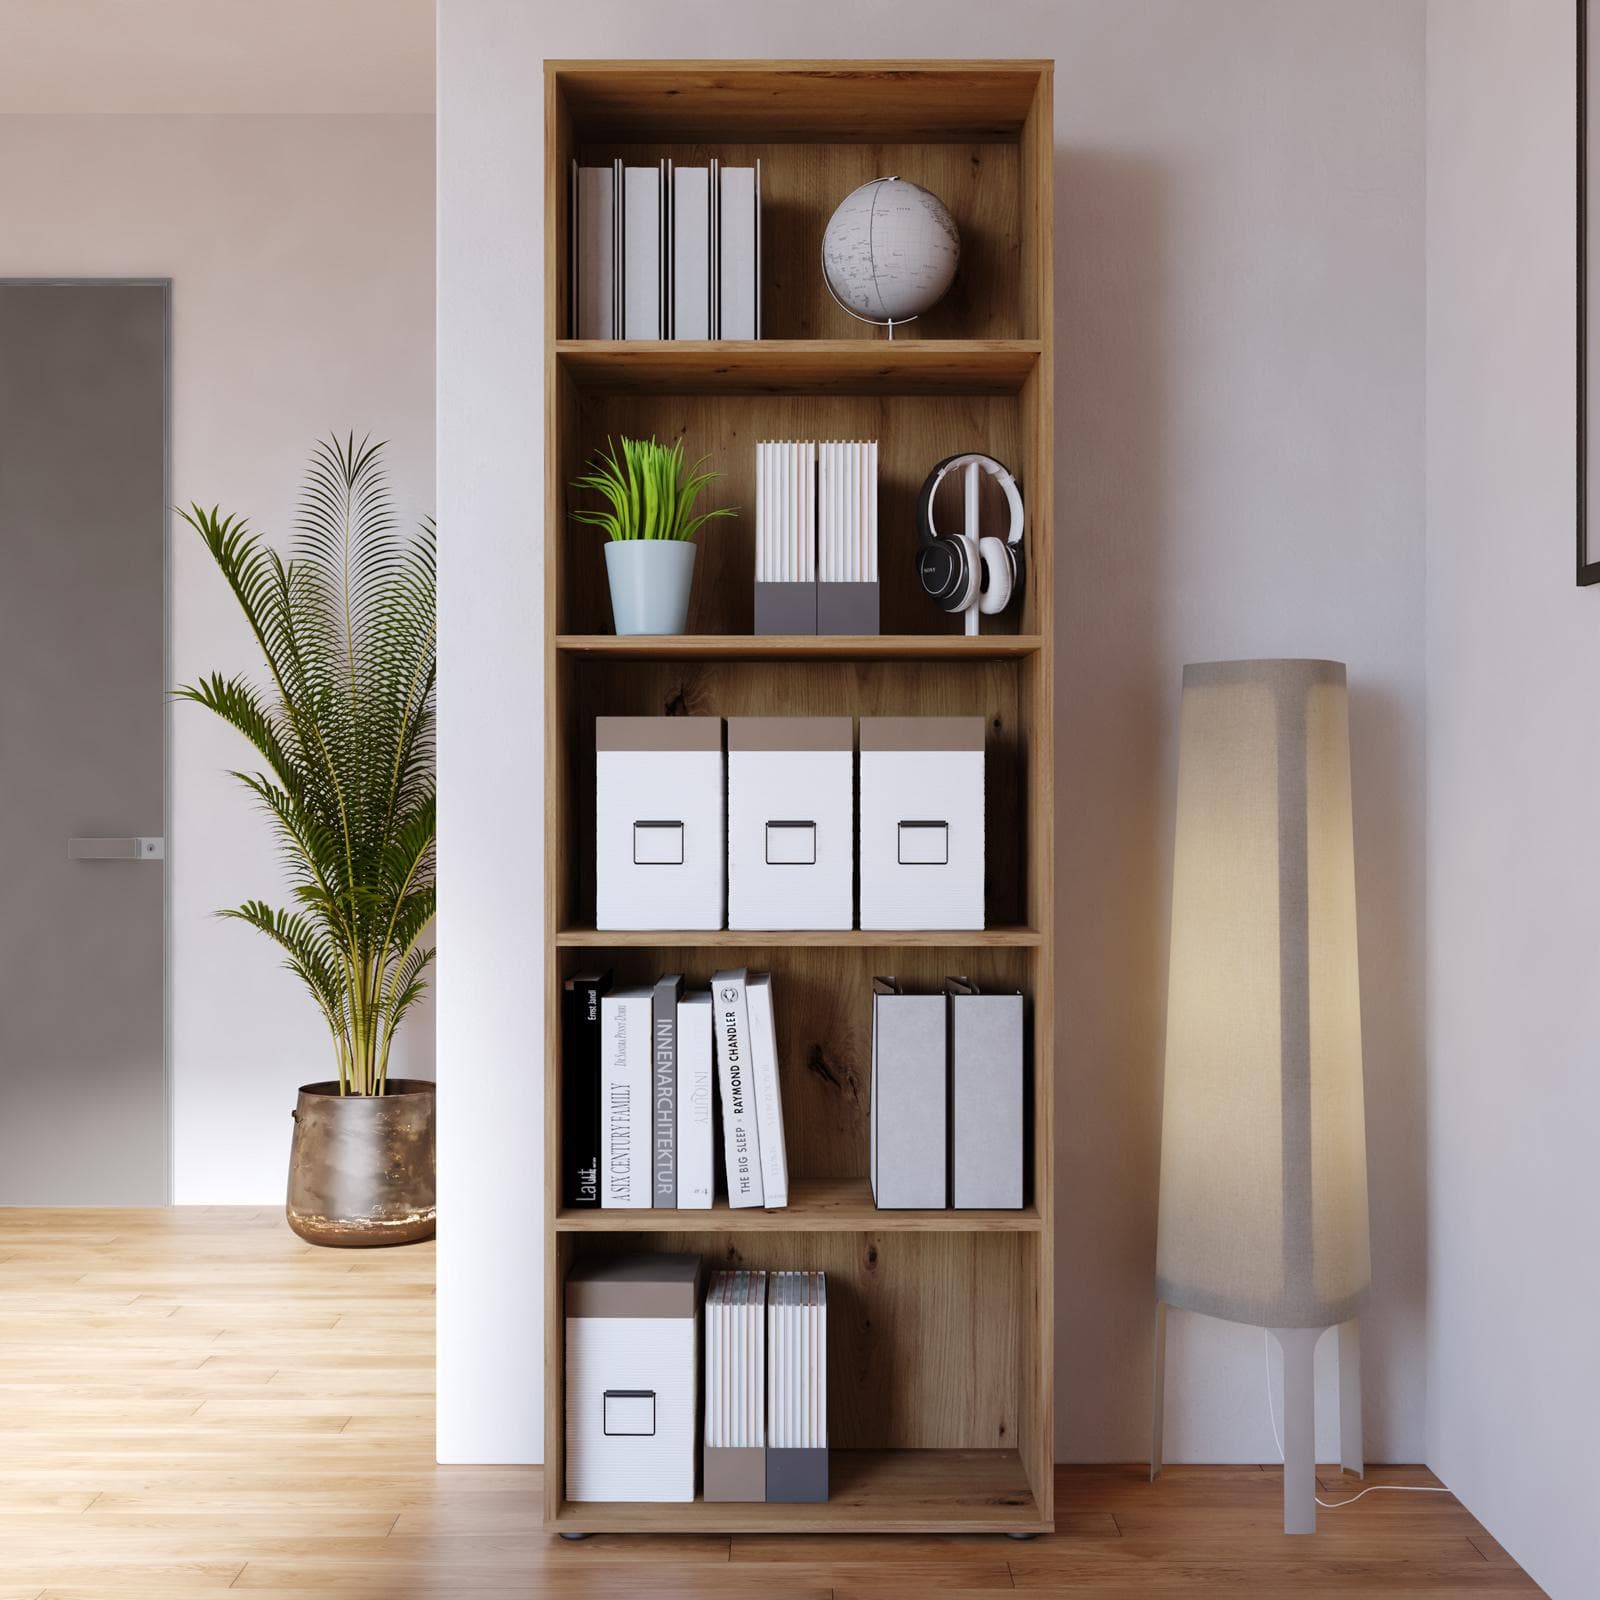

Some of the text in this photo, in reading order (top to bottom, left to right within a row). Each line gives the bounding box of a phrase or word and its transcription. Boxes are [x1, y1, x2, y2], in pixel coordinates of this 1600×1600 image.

[610, 1082, 631, 1202] A SIX CENTURY FAMILY
[656, 1018, 673, 1195] INNENARCHITEKTUR
[690, 1071, 709, 1125] INIQUITY
[725, 1011, 751, 1194] THE BIG SLEEP RAYMOND CHANDLER
